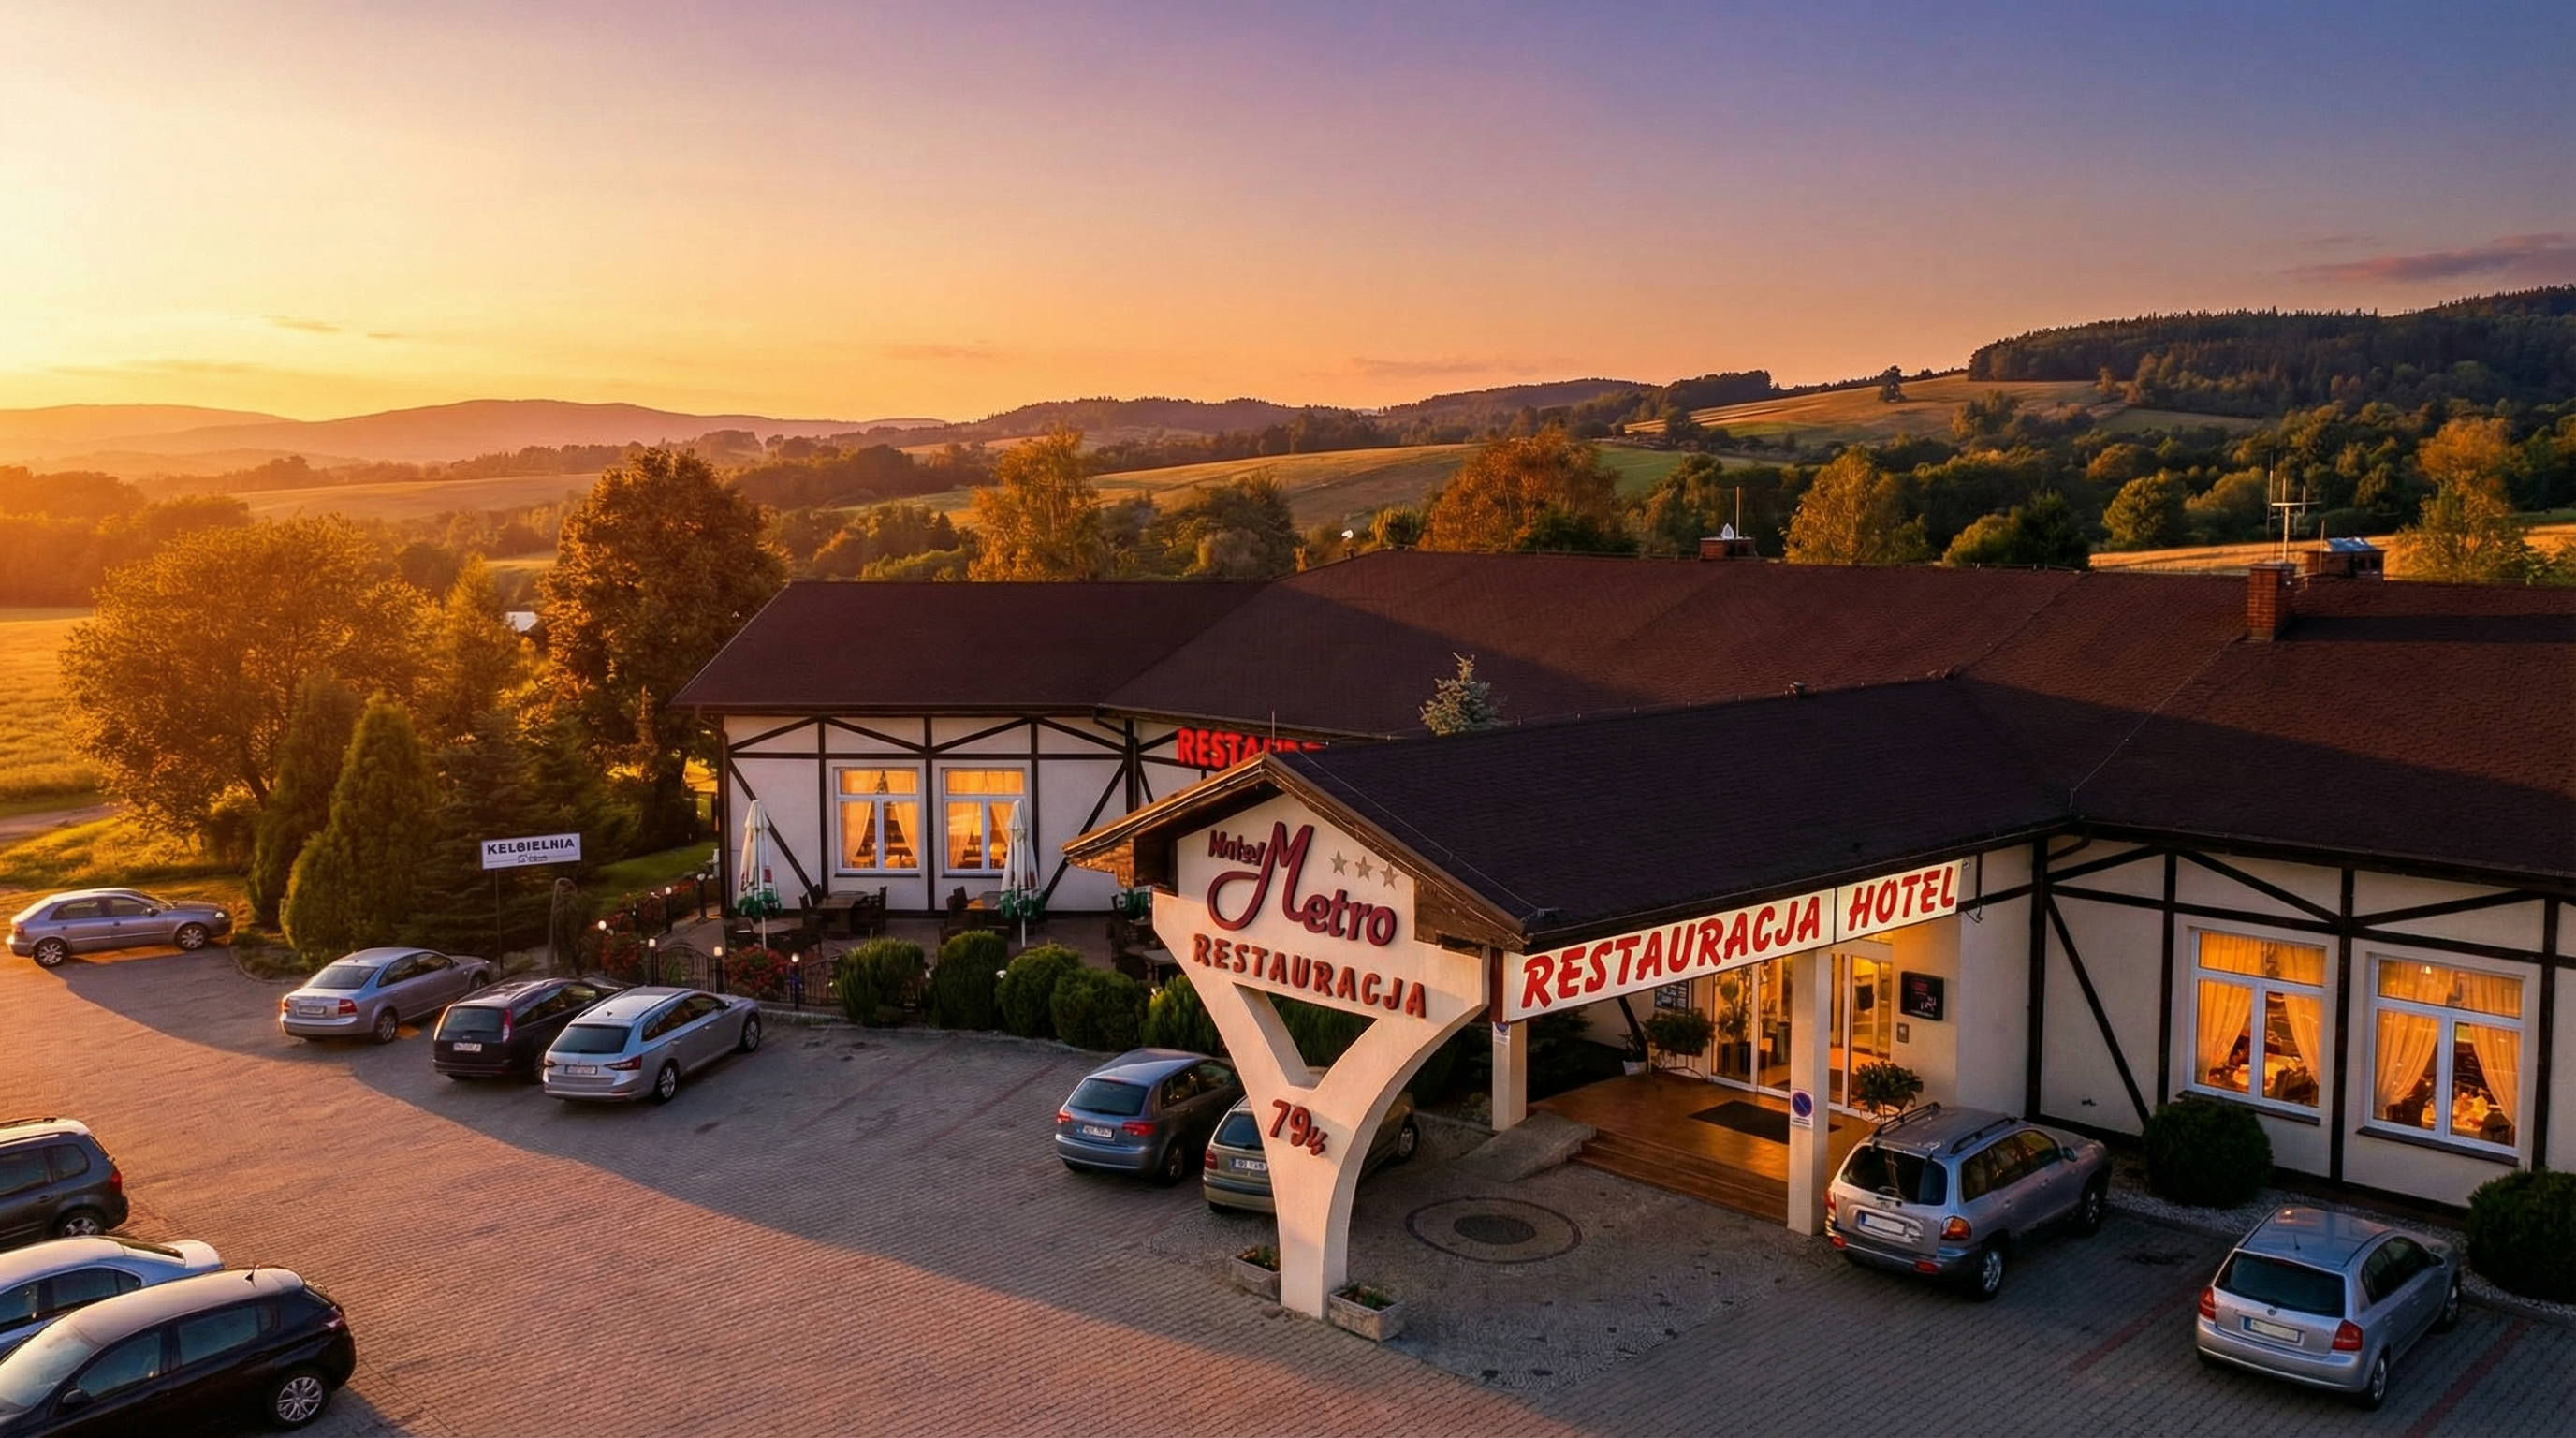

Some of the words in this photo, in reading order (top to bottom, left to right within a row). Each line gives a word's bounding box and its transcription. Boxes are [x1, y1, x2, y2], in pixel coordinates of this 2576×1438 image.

[1208, 821, 1397, 946] Metro
[1521, 896, 1821, 1009] RESTAURACJA
[1848, 866, 1954, 931] HOTEL
[1193, 933, 1427, 1019] RESTAURACJA
